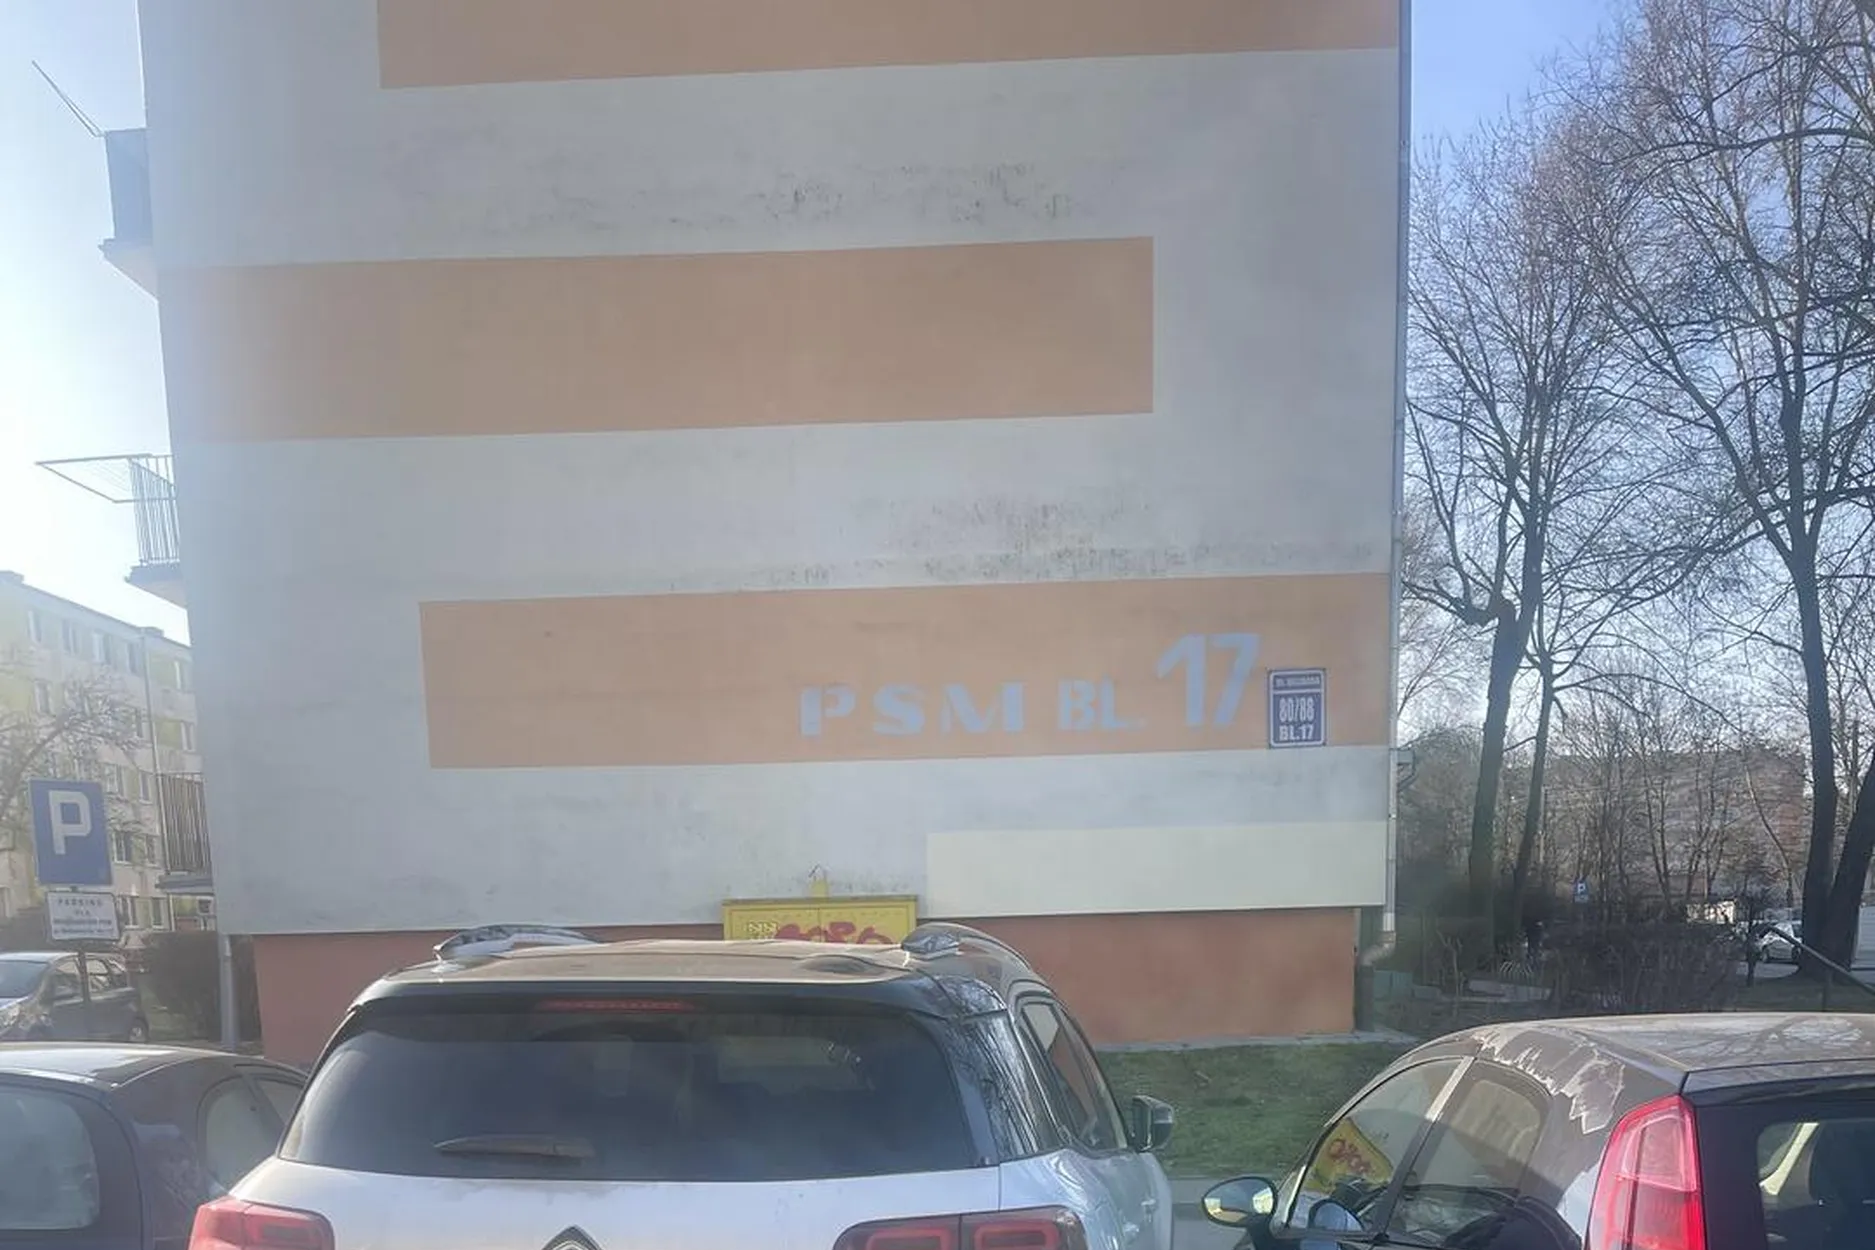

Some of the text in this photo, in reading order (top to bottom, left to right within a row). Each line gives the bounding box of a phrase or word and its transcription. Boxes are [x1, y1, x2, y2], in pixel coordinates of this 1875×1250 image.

[800, 681, 1025, 737] PSM
[1154, 632, 1260, 728] 17
[1279, 695, 1314, 722] 80/88
[48, 790, 92, 855] P
